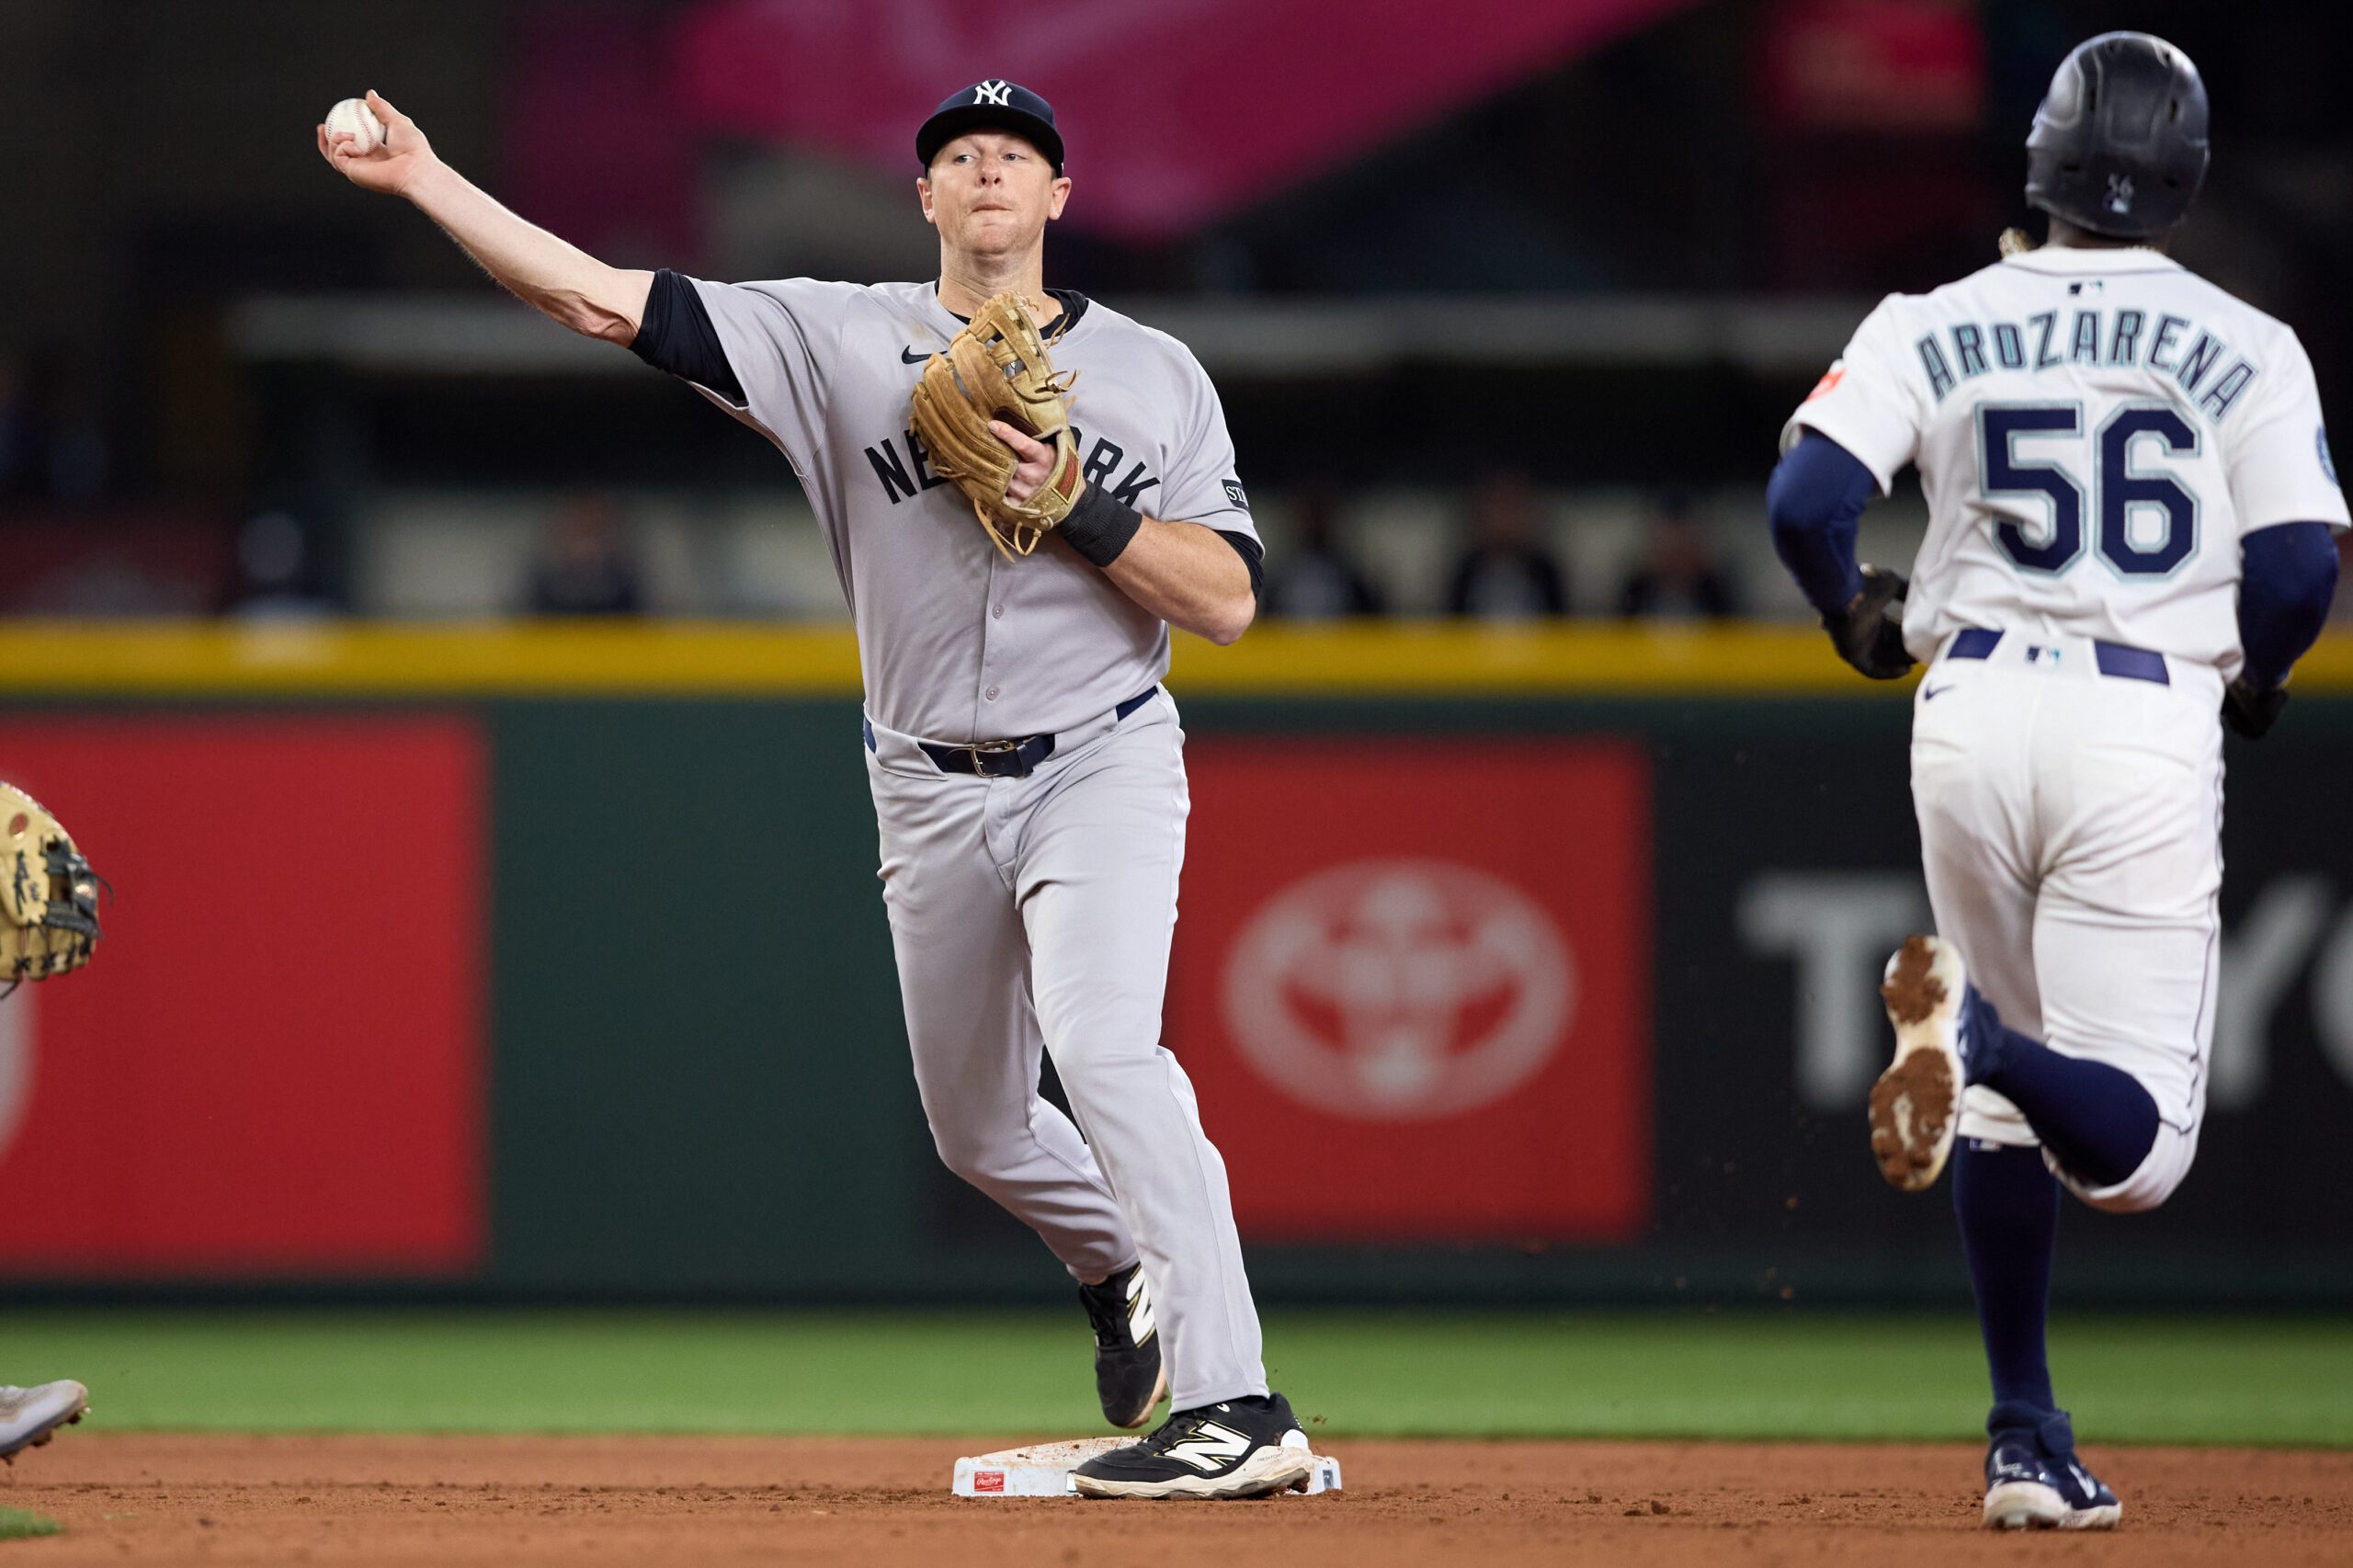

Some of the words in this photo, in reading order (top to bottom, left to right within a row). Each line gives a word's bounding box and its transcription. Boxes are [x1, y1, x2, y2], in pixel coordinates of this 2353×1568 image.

[972, 80, 1012, 107] NY
[1915, 308, 2258, 426] AROZARENA
[864, 428, 950, 505] NE
[1069, 426, 1161, 507] RK
[1974, 398, 2201, 584] 56
[1740, 871, 2353, 1112] TY
